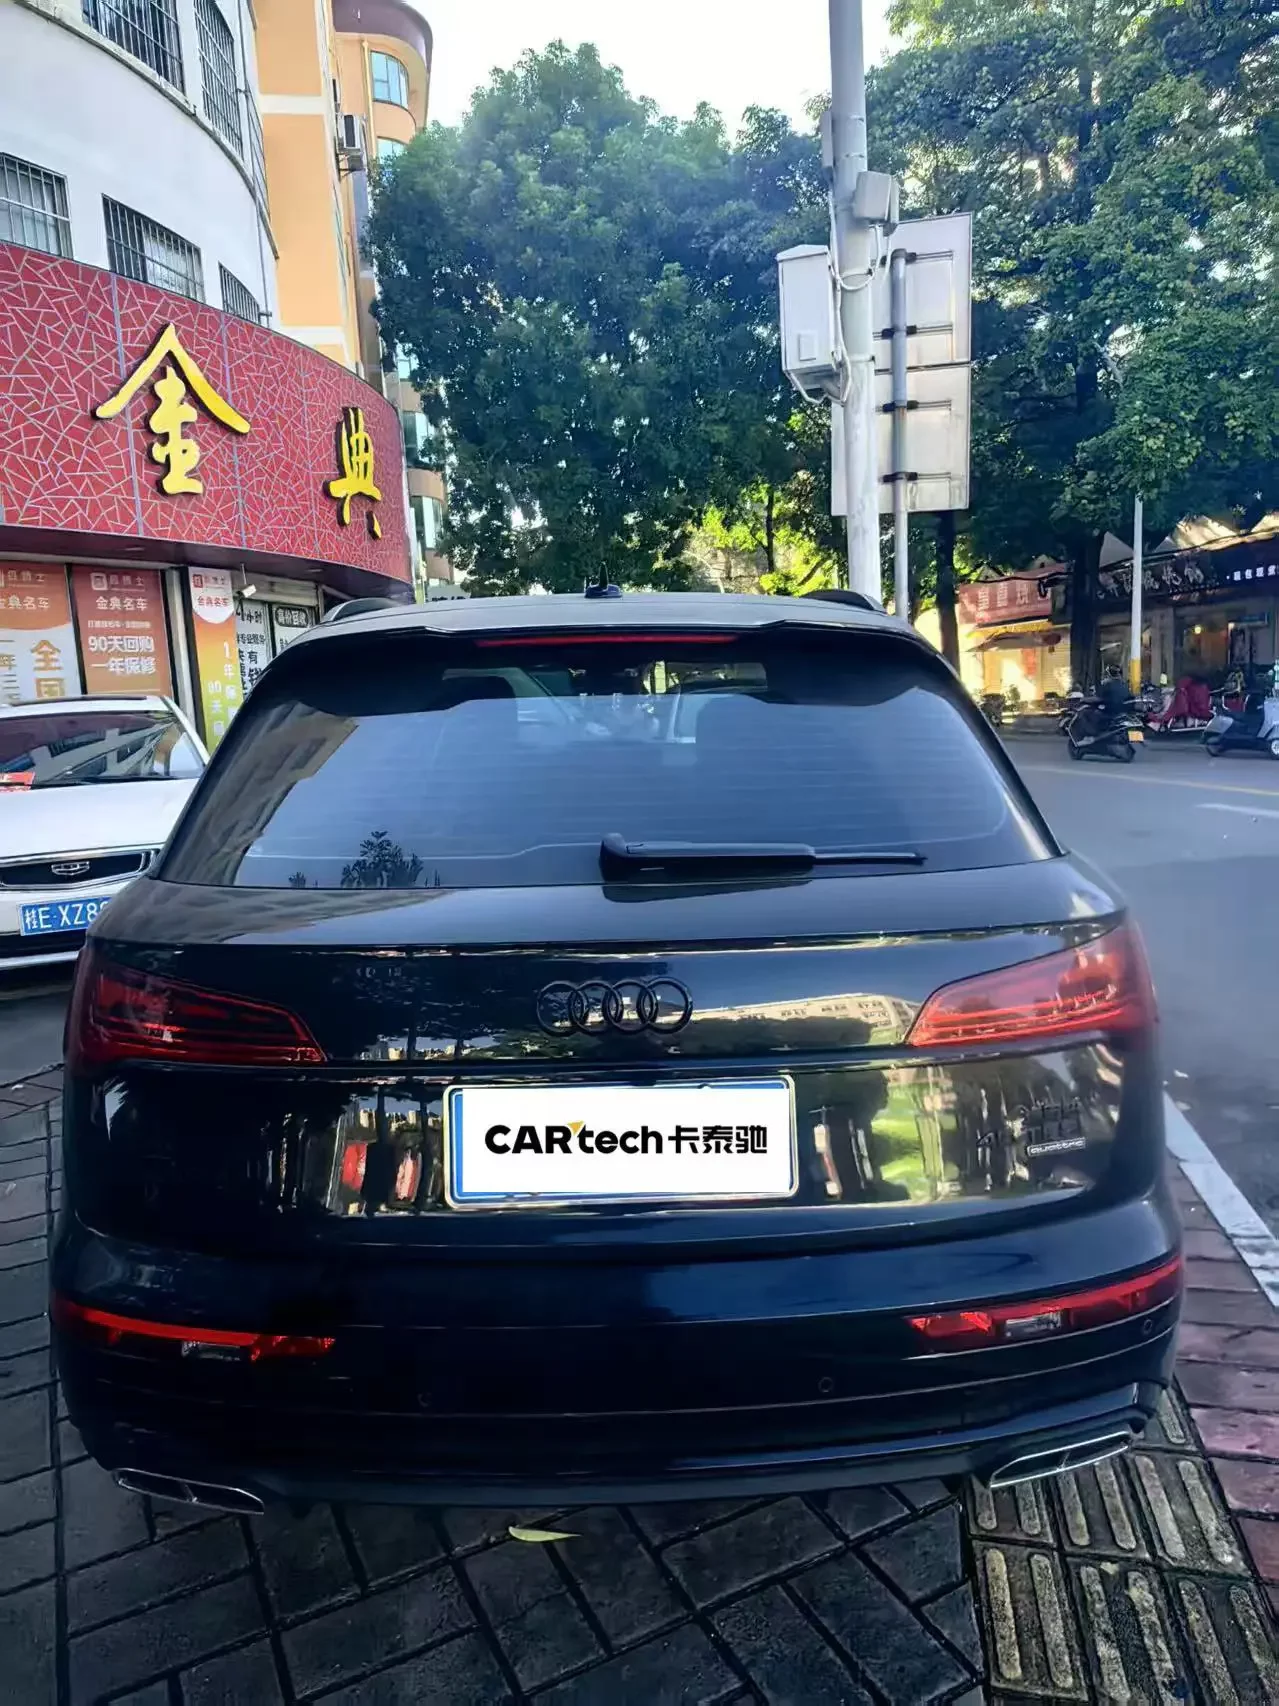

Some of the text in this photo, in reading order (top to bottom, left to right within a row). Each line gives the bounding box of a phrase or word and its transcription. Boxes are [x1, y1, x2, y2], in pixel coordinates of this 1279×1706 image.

[95, 595, 148, 611] 金典名车
[87, 635, 156, 653] 90天回购
[91, 656, 157, 676] 一年保修
[25, 900, 111, 930] 桂E·XZ8
